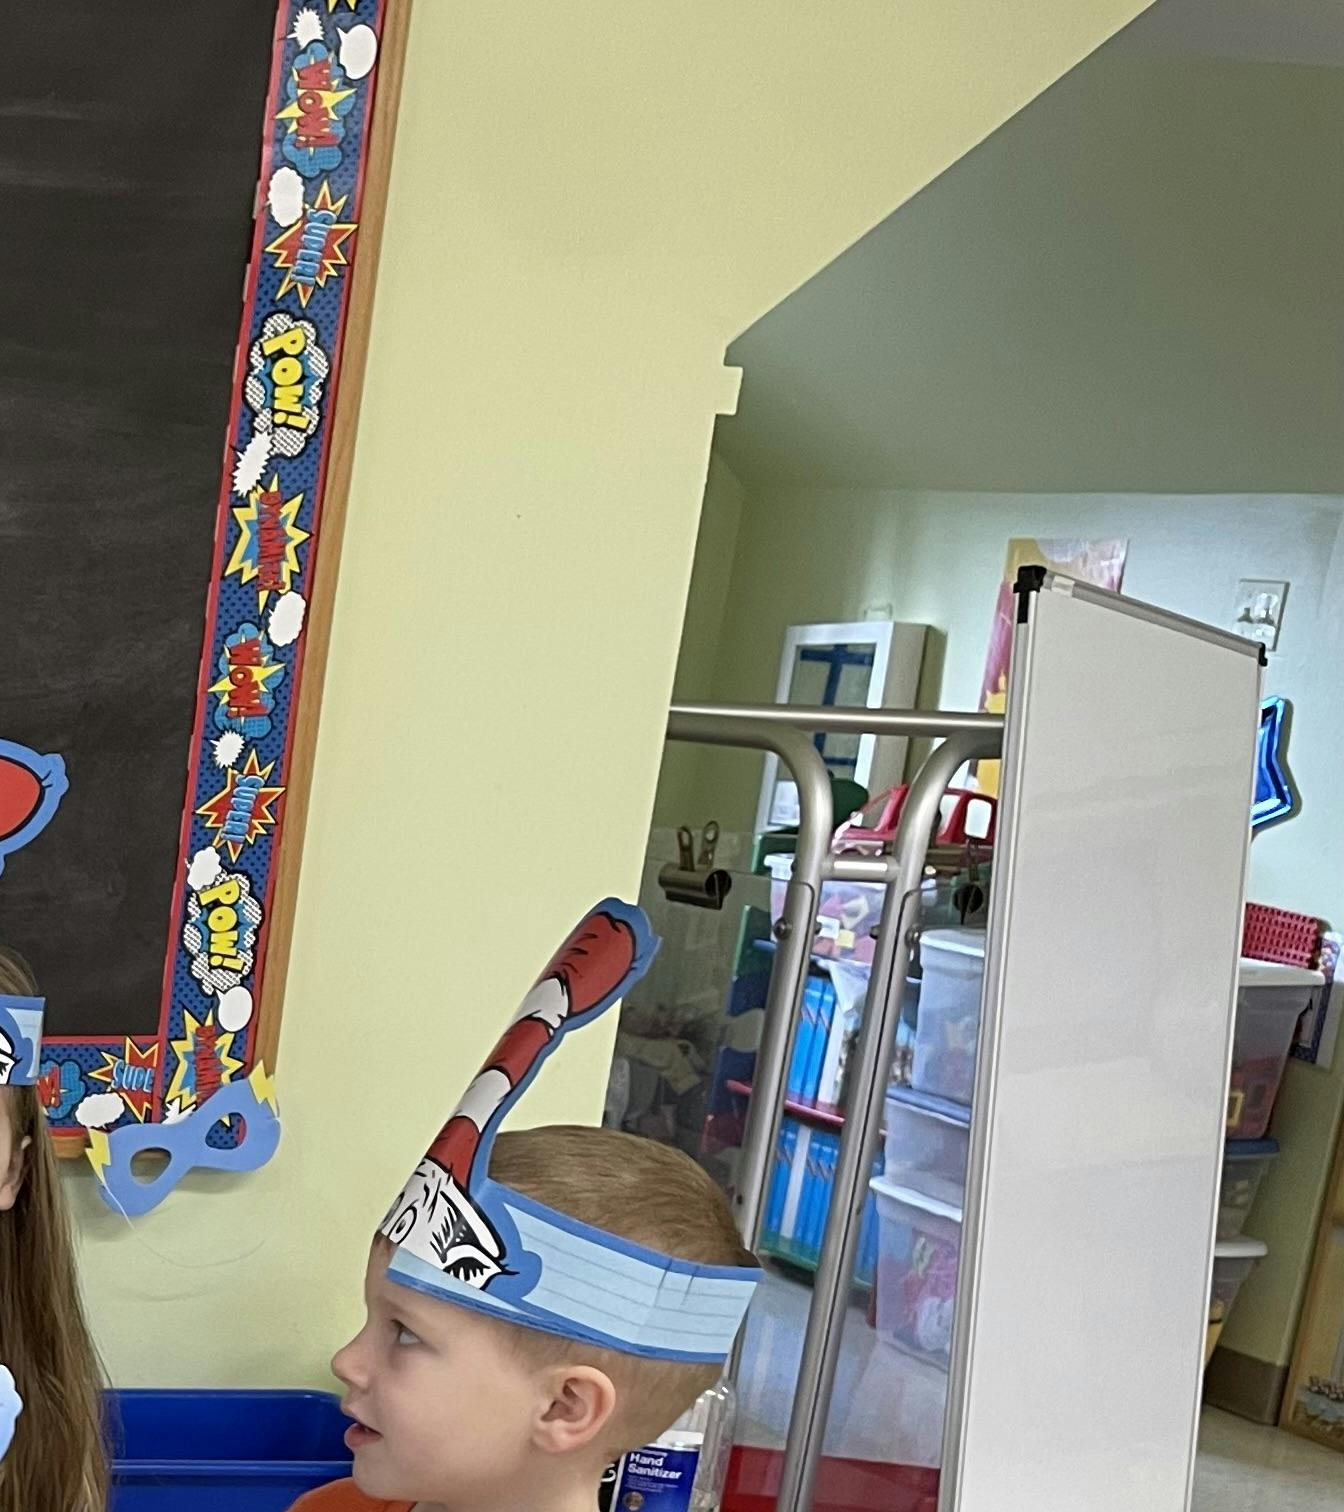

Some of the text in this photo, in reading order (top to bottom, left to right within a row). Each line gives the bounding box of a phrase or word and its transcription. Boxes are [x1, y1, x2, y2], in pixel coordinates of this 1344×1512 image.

[293, 57, 341, 149] WOW!
[262, 327, 311, 431] POW!
[226, 637, 270, 719] WOW!
[198, 879, 244, 971] POW!
[627, 1462, 683, 1480] Sanitizer
[630, 1452, 665, 1467] Hand
